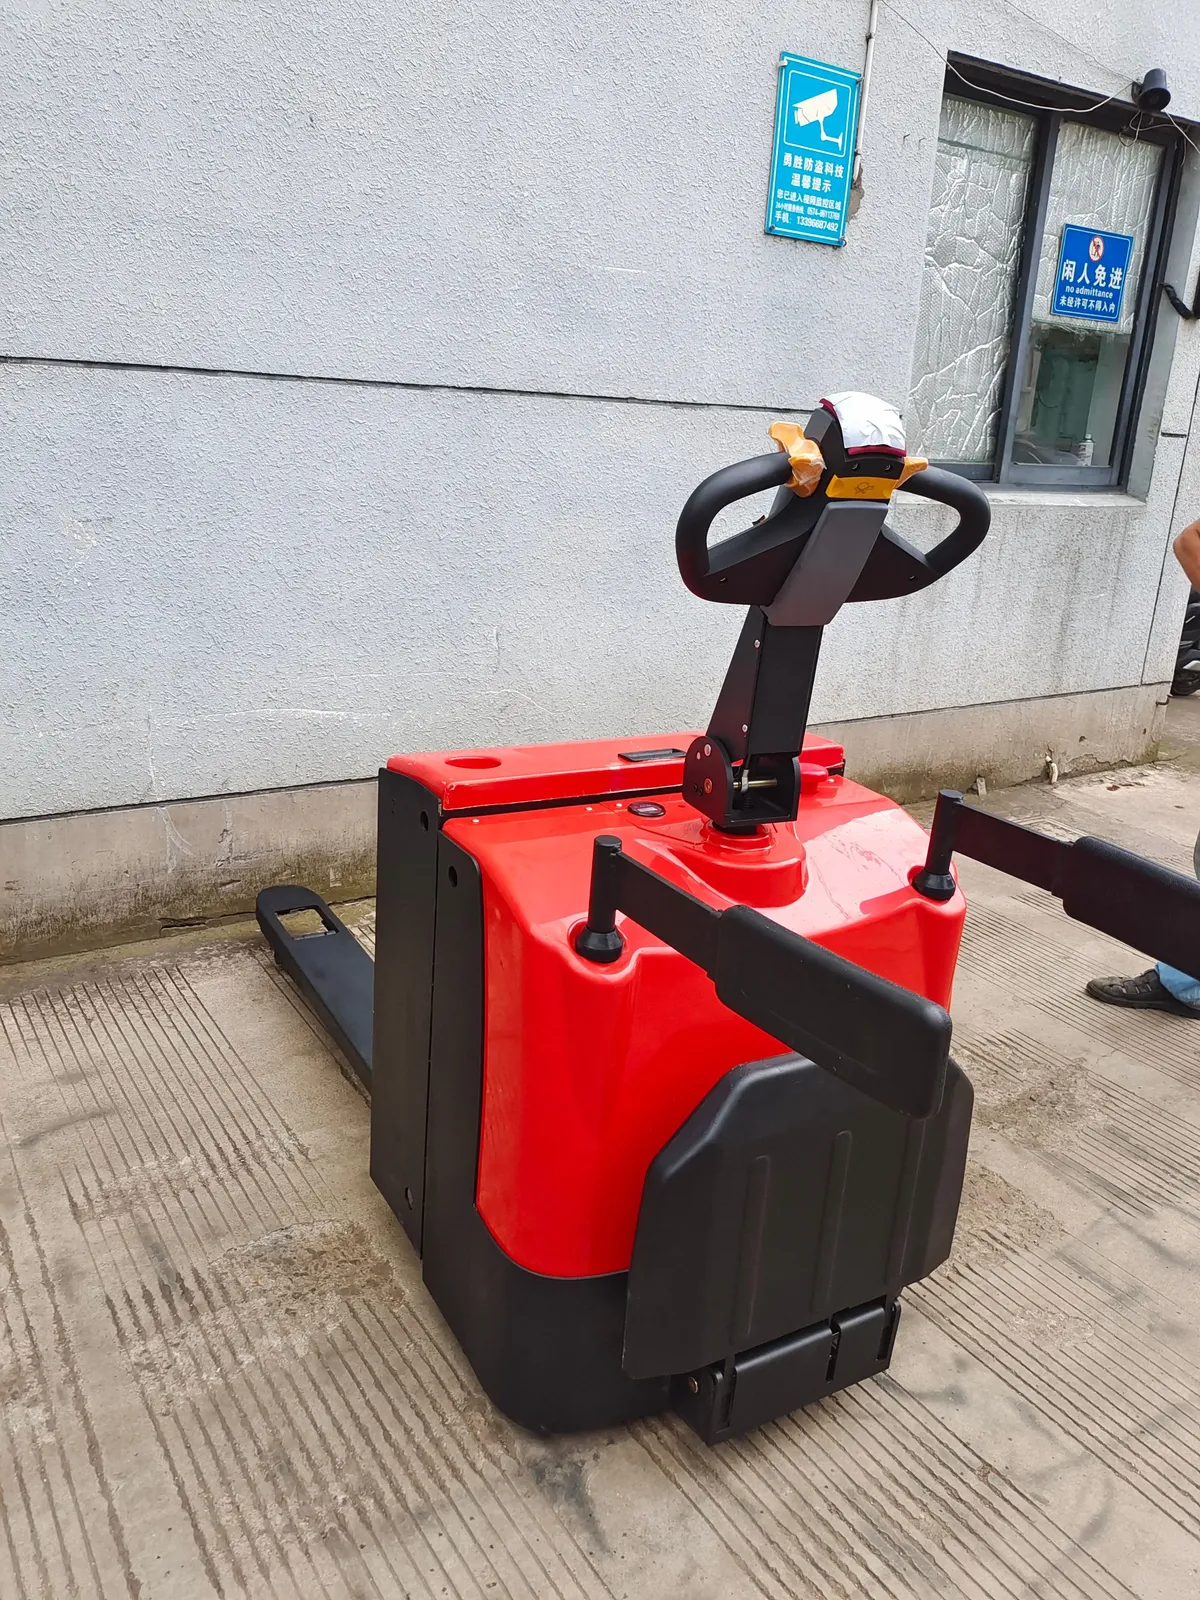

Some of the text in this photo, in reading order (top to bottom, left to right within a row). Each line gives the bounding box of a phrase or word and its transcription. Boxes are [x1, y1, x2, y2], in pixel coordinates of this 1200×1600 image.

[783, 152, 844, 178] 勇胜防盗科技
[791, 173, 832, 193] 温馨提示
[1061, 259, 1122, 289] 闲人免进
[1065, 285, 1113, 299] no admittance
[1059, 295, 1115, 313] 未经许可不得入内
